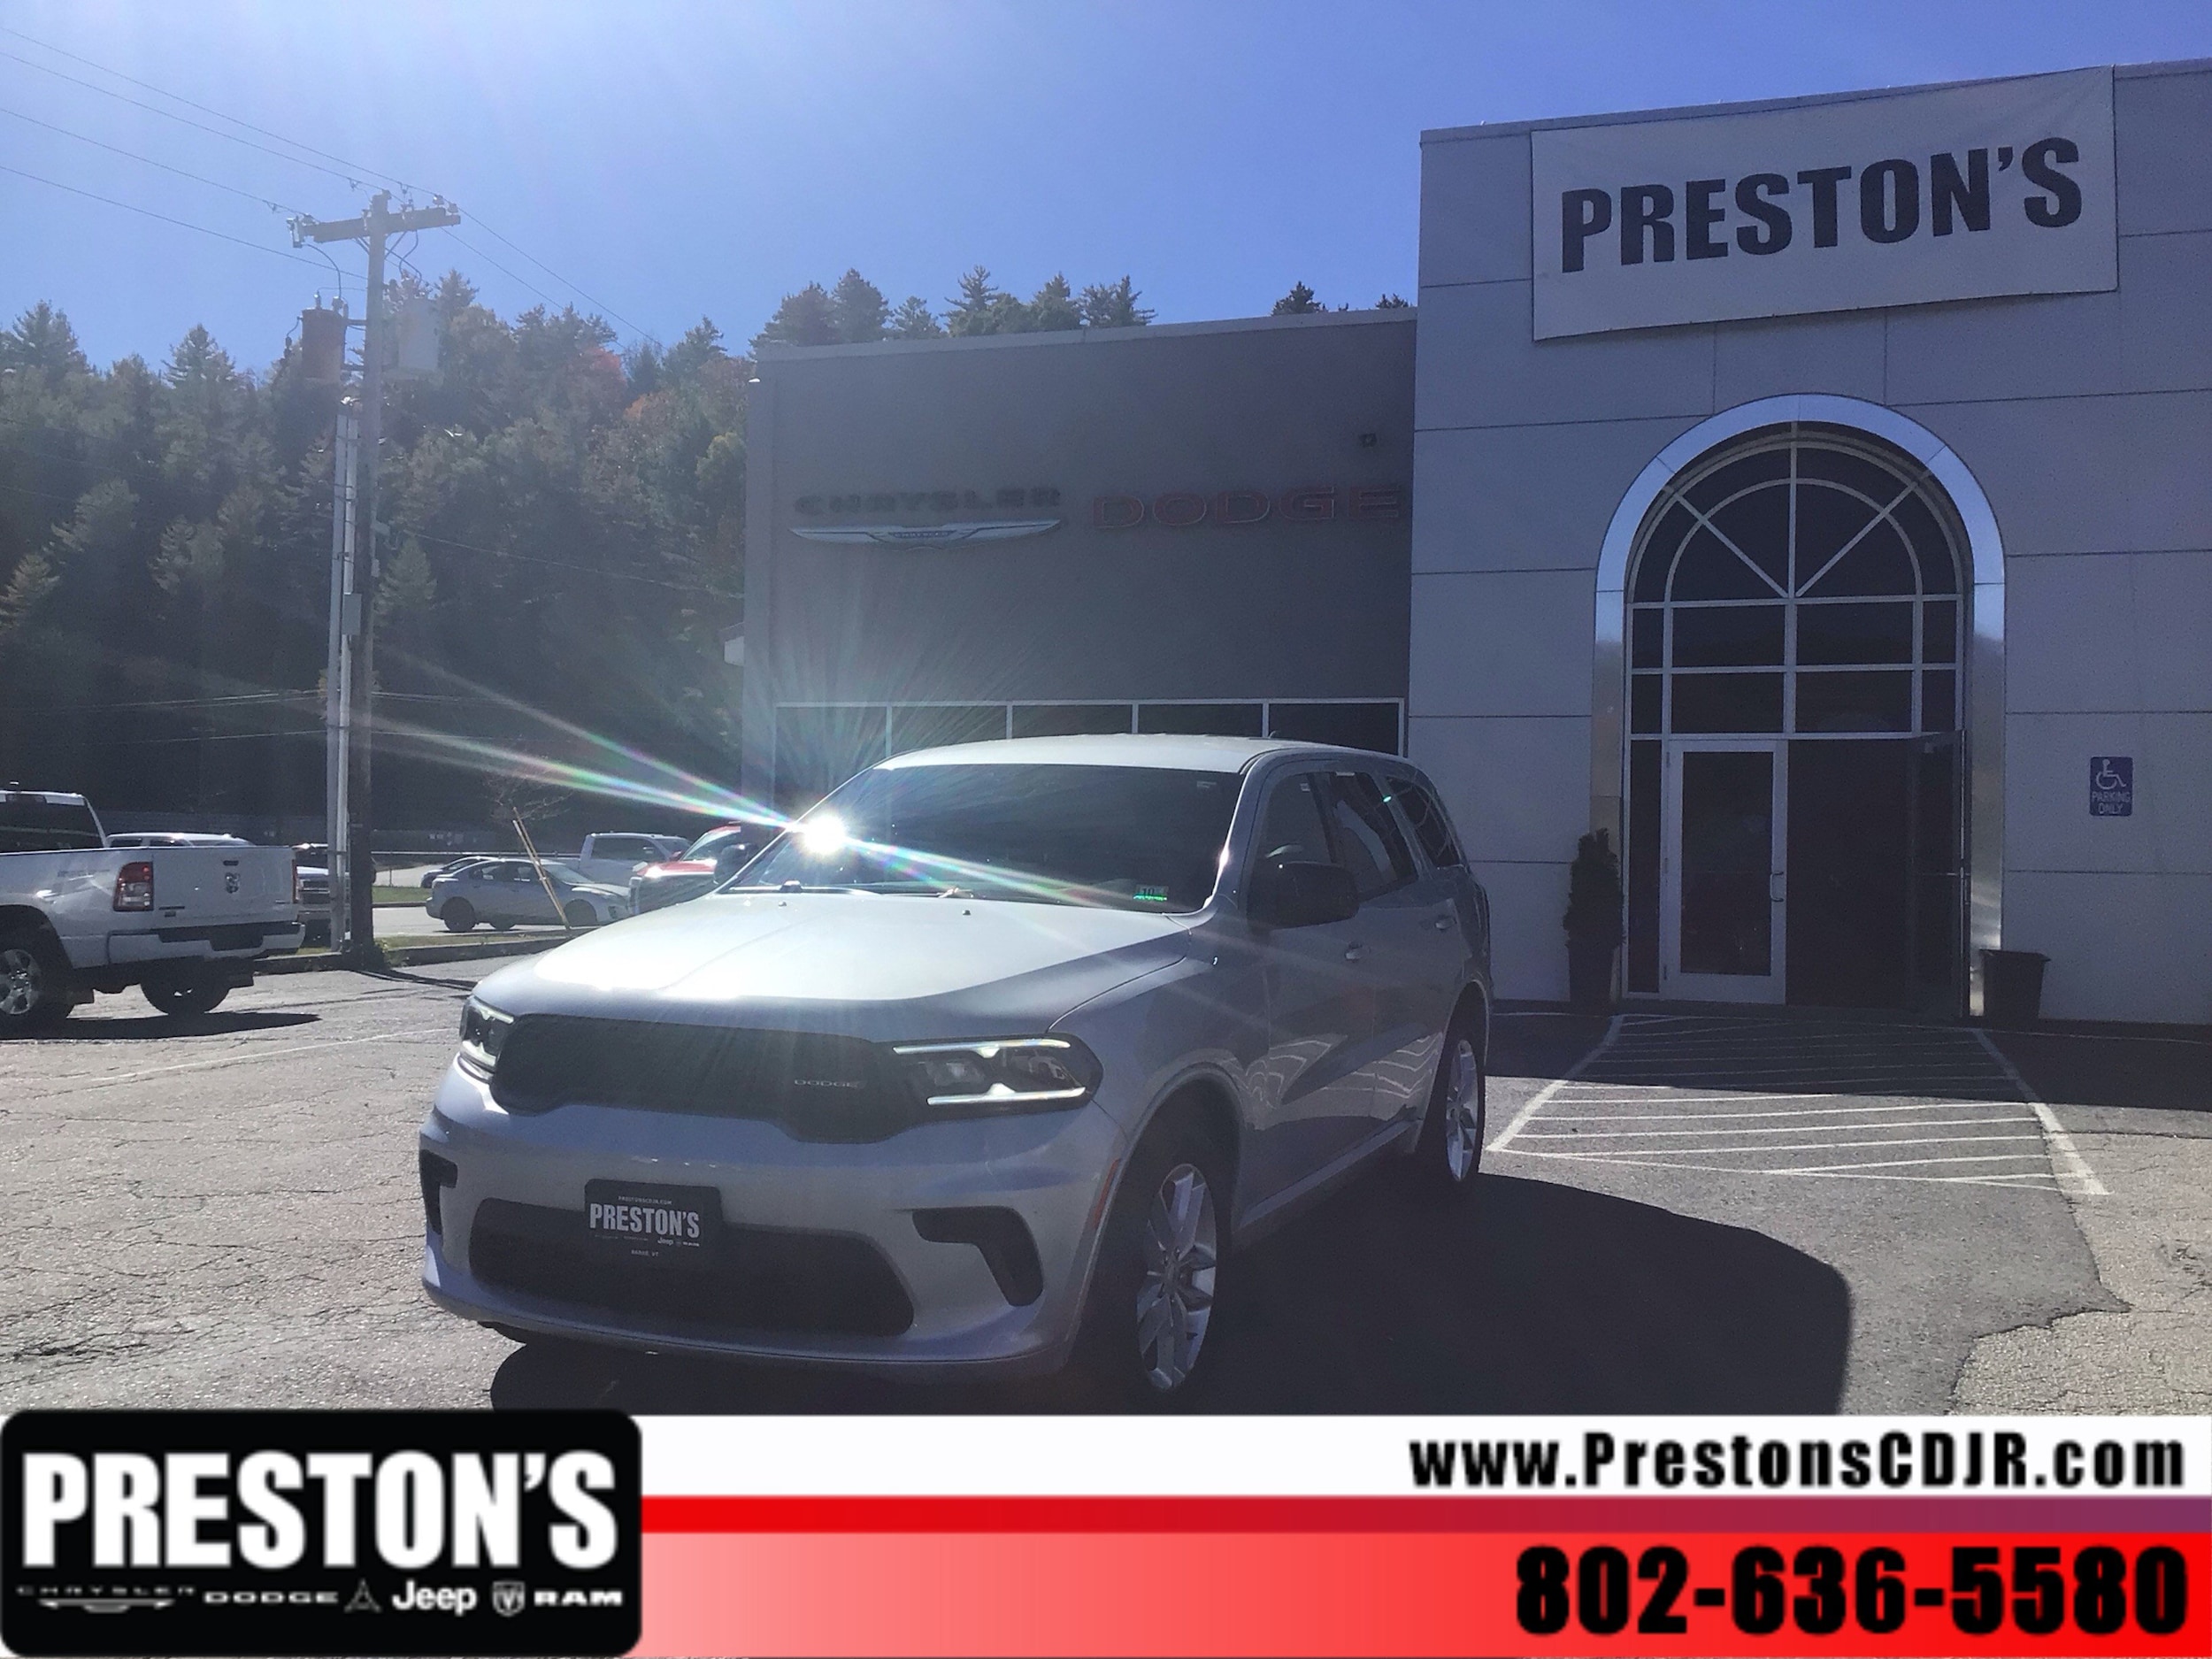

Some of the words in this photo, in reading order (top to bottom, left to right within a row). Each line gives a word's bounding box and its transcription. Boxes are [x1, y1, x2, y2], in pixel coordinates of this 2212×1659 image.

[1561, 136, 2082, 273] PRESTON'S
[794, 487, 1061, 516] CHRYSLER
[1093, 483, 1406, 531] DODGE
[2092, 790, 2131, 803] PARKING
[2098, 802, 2124, 814] ONLY
[794, 1079, 860, 1089] DODGE
[589, 1202, 701, 1239] PRESTON'S
